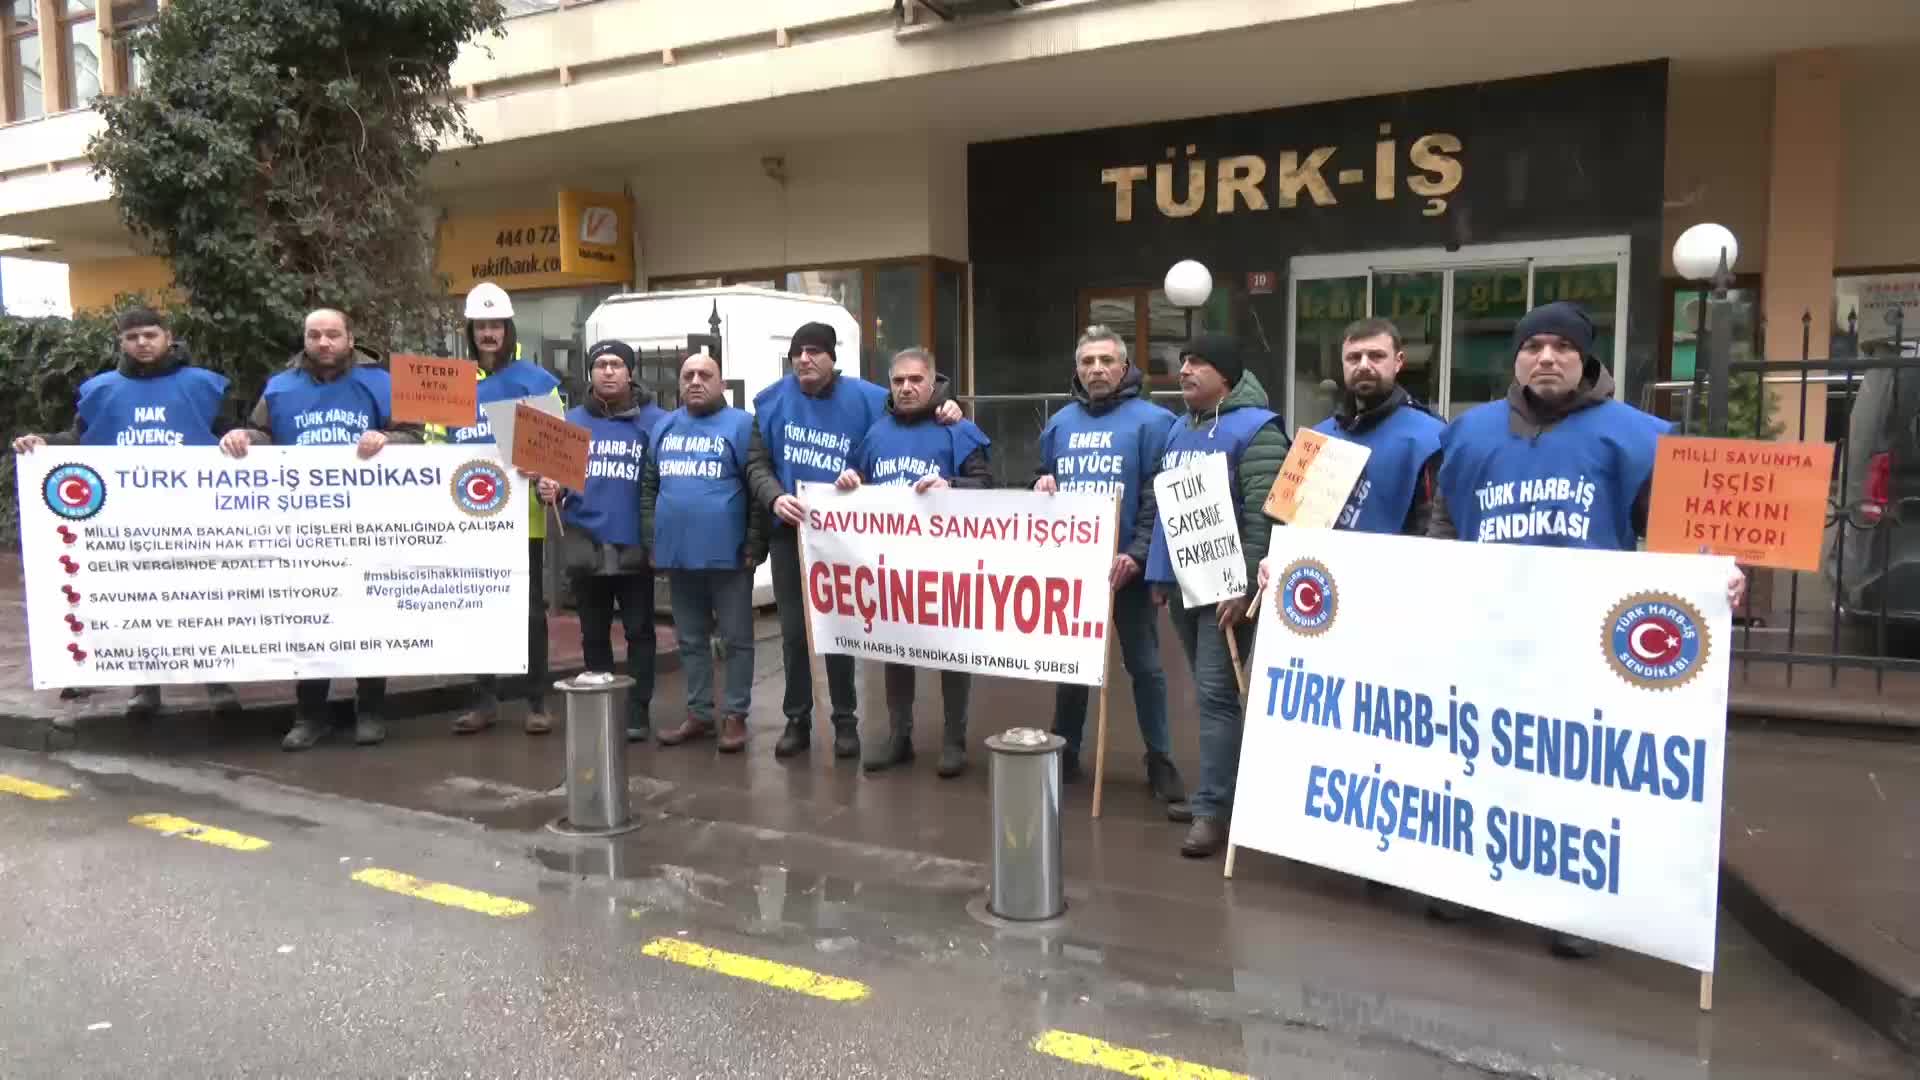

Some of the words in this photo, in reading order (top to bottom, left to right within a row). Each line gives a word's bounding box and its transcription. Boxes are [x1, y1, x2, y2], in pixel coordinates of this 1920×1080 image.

[1101, 122, 1463, 222] TÜRK-İŞ
[496, 228, 521, 248] 444
[527, 227, 536, 244] 0
[540, 224, 560, 243] 72
[471, 253, 561, 278] vakifbank.co
[134, 406, 167, 423] HAK
[294, 409, 323, 429] TÜRK
[325, 408, 369, 431] HARB-İŞ
[116, 425, 184, 447] GÜVENCE
[661, 432, 684, 451] TÜRK
[685, 434, 725, 456] HARB-İŞ
[807, 427, 851, 456] HARB-İŞ
[1068, 431, 1113, 449] EMEK
[598, 439, 643, 459] HARB-İŞ
[783, 443, 847, 474] SNDİKASI
[1672, 447, 1717, 463] MİLLİ
[1726, 451, 1813, 468] SAVUNMA
[659, 456, 722, 478] SENDİKASI
[873, 456, 897, 478] ÜRK
[1057, 455, 1075, 475] EN
[1078, 450, 1124, 474] YÜCE
[115, 466, 188, 489] TÜRK
[199, 464, 300, 491] HARB-İŞ
[309, 463, 441, 487] SENDİKASI
[215, 491, 271, 511] İZMİR
[277, 490, 351, 512] ŞUBESİ
[1475, 480, 1516, 511] TÜRK
[1519, 475, 1596, 512] HARB-İŞ
[1167, 503, 1225, 539] SAYENDE
[1685, 497, 1789, 522] HAKKINI
[85, 524, 120, 538] MİLLİ
[124, 526, 192, 538] SAVUNMA
[197, 524, 272, 537] BAKANLIĞI
[276, 524, 291, 535] VE
[296, 521, 352, 536] İÇİŞLERİ
[356, 521, 455, 534] BAKANLIĞINDA
[458, 520, 514, 533] ÇALIŞAN
[809, 509, 922, 537] SAVUNMA
[929, 512, 1019, 541] SANAYİ
[1027, 512, 1101, 548] İŞÇİSİ
[1477, 505, 1591, 544] SENDİKASI
[86, 540, 125, 551] KAMU
[216, 539, 243, 550] HAK
[88, 559, 129, 573] GELİR
[133, 558, 217, 572] VERGİSİNDE
[221, 558, 274, 570] ADALET
[89, 591, 158, 603] SAVUNMA
[161, 589, 224, 602] SANAYİSİ
[227, 588, 265, 601] PRİMİ
[91, 620, 110, 631] EK
[122, 618, 151, 630] ZAM
[156, 618, 173, 629] VE
[178, 617, 224, 628] REFAH
[227, 615, 256, 627] PAYI
[1615, 607, 1646, 633] TÜRK
[94, 647, 134, 659] KAMU
[137, 645, 195, 660] İŞÇİLERİ
[199, 645, 216, 656] VE
[221, 642, 282, 655] AİLELERİ
[285, 641, 325, 653] İNSAN
[329, 639, 356, 652] GİBİ
[360, 638, 382, 650] BİR
[386, 638, 434, 651] YAŞAMI
[835, 636, 861, 650] TÜRK
[863, 640, 906, 658] HARB-İŞ
[908, 646, 969, 665] SENDİKASI
[971, 651, 1031, 671] İSTANBUL
[1034, 660, 1080, 675] ŞUBESİ
[96, 661, 125, 672] HAK
[129, 659, 189, 671] ETMİYOR
[1619, 651, 1690, 677] SENDİKASI
[1265, 656, 1345, 730] TÜRK
[1352, 684, 1480, 777] HARB-İŞ
[1490, 707, 1707, 803] SENDİKASI
[1304, 763, 1475, 853] ESKİŞEHİR
[1486, 805, 1621, 895] ŞUBESİ
